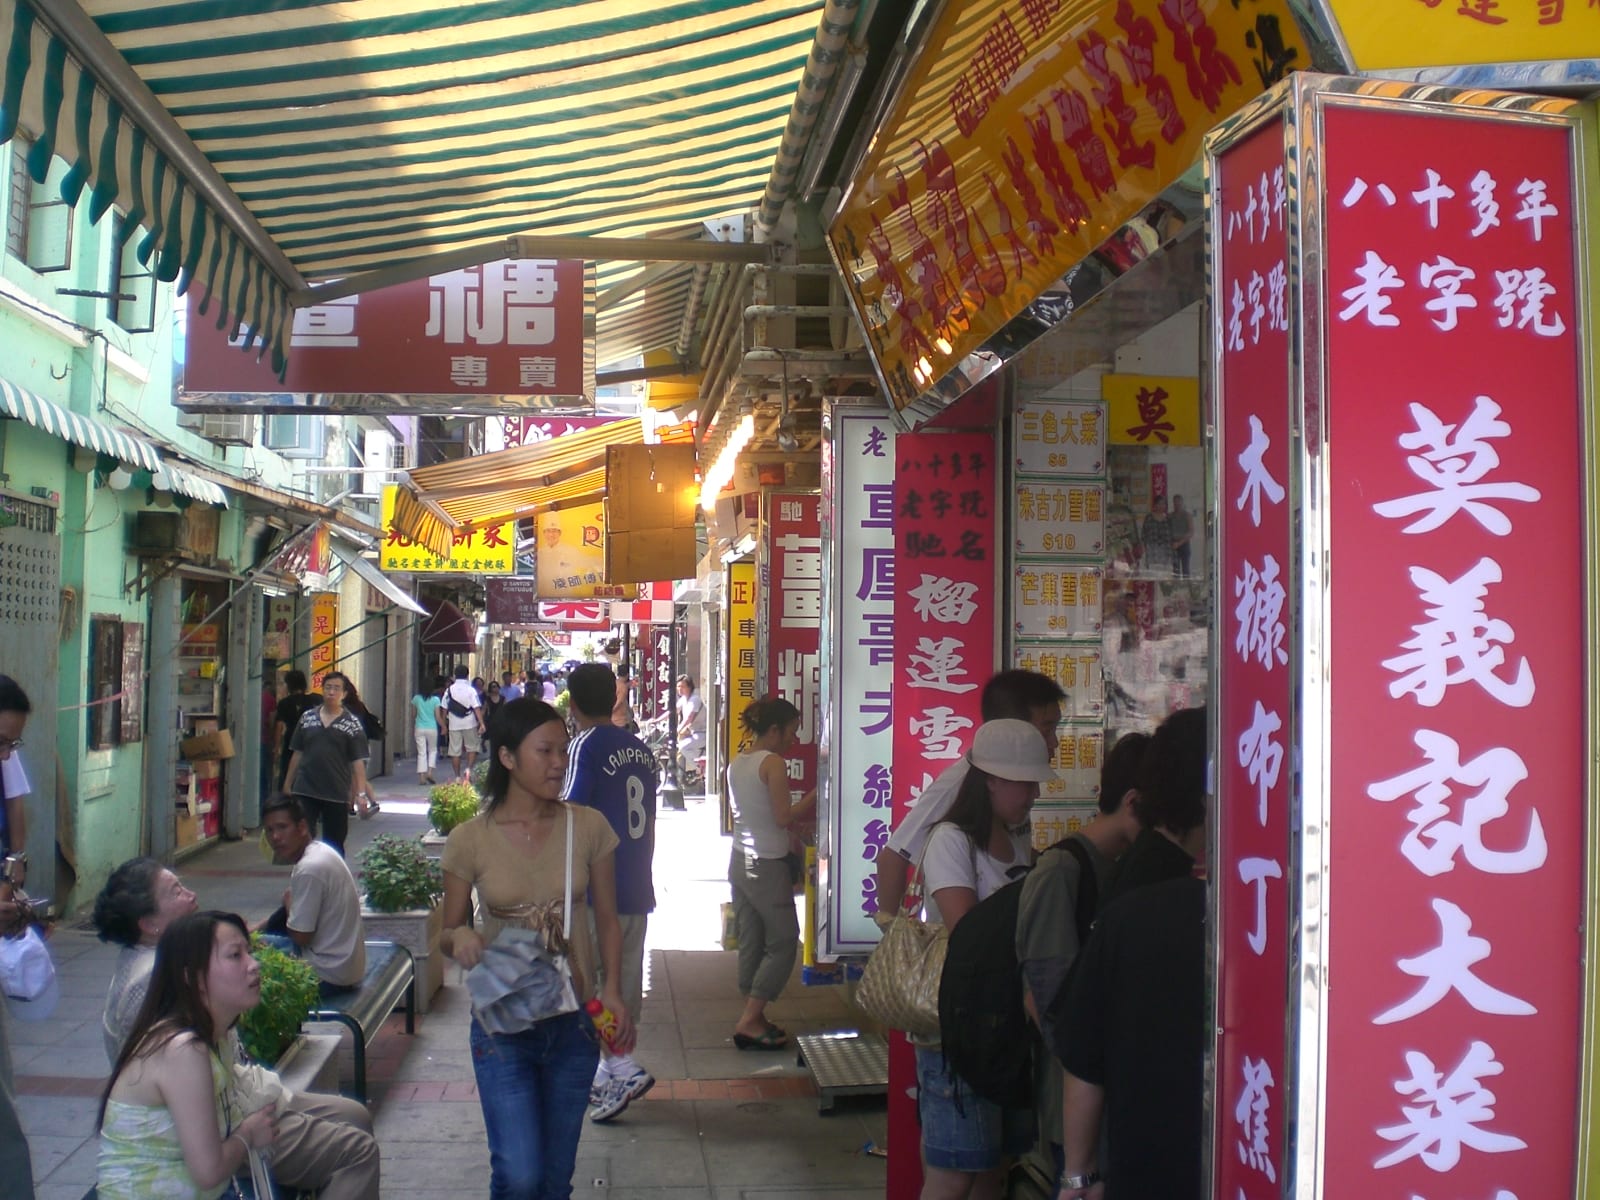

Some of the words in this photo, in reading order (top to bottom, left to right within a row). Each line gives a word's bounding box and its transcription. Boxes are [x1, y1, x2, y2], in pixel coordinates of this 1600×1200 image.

[1227, 164, 1287, 244] 八十多年
[1342, 169, 1558, 241] 八十多年
[1228, 260, 1289, 351] 老字號
[1338, 250, 1567, 338] 老字號
[450, 355, 557, 388] 專賣
[1022, 410, 1098, 445] 三色大菜
[1126, 386, 1176, 444] 莫
[901, 451, 987, 480] 八十多年
[899, 487, 989, 519] 老字號
[1019, 488, 1101, 523] 朱古力雪糕
[904, 529, 986, 561] 馳名
[1042, 533, 1076, 550] $10
[903, 573, 979, 809] 榴蓮雪
[626, 776, 646, 839] 8
[1366, 395, 1549, 1200] 莫義記大菜
